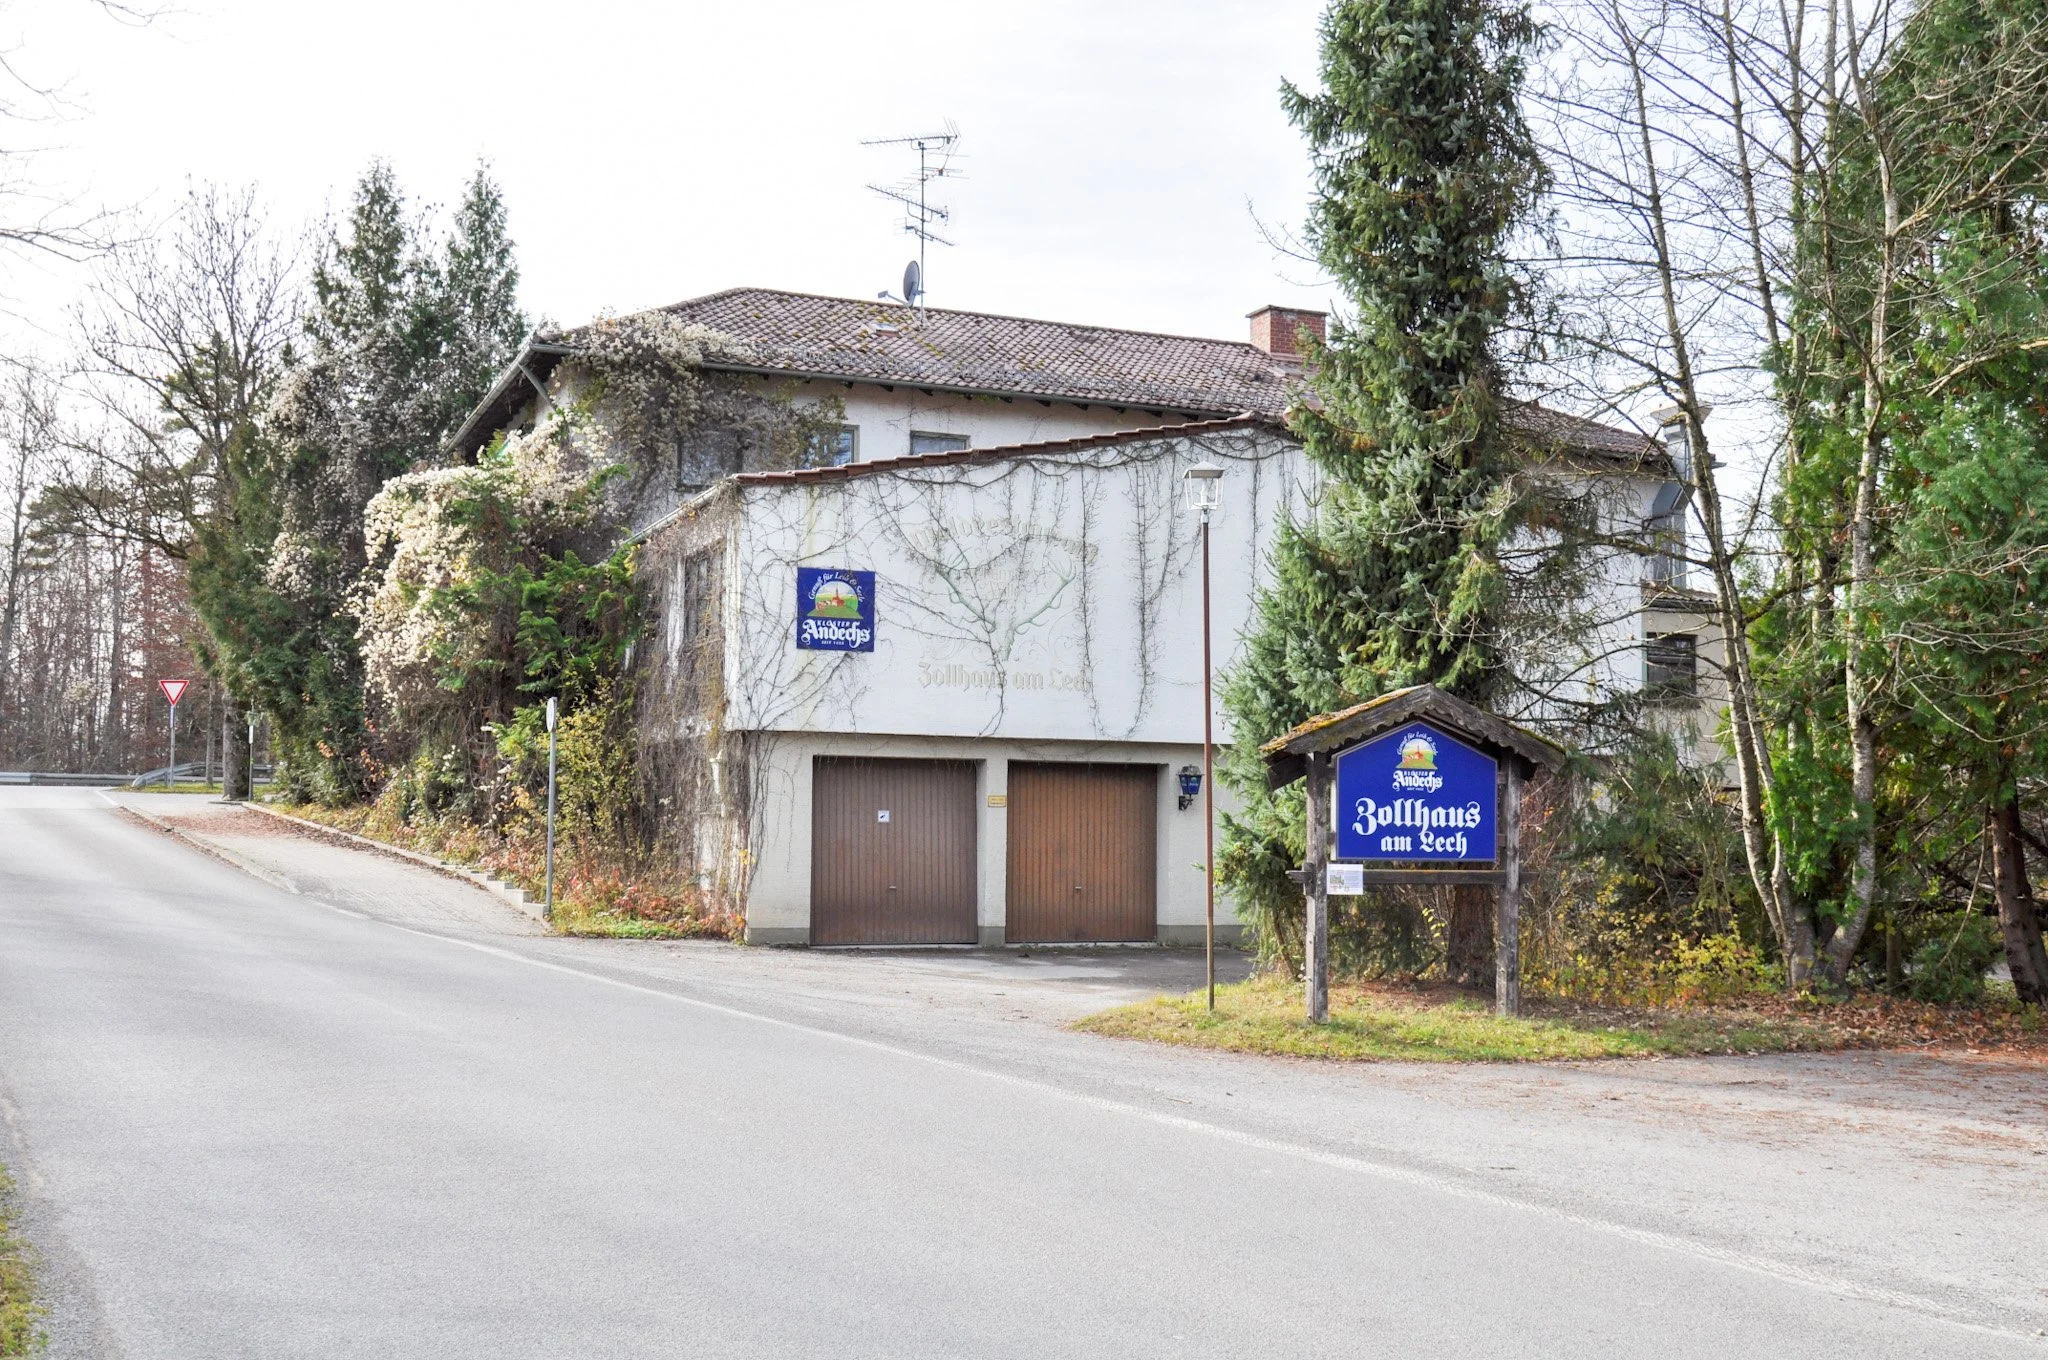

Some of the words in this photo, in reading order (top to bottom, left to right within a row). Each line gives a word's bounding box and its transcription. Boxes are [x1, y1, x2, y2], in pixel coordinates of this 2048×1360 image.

[823, 572, 833, 585] für
[801, 619, 871, 648] Andechs
[817, 619, 851, 627] KLOSTER
[1012, 671, 1044, 690] am
[1392, 769, 1443, 793] Andechs
[1352, 797, 1481, 835] Zollhaus
[1380, 835, 1412, 852] am
[1419, 831, 1468, 858] Lech
